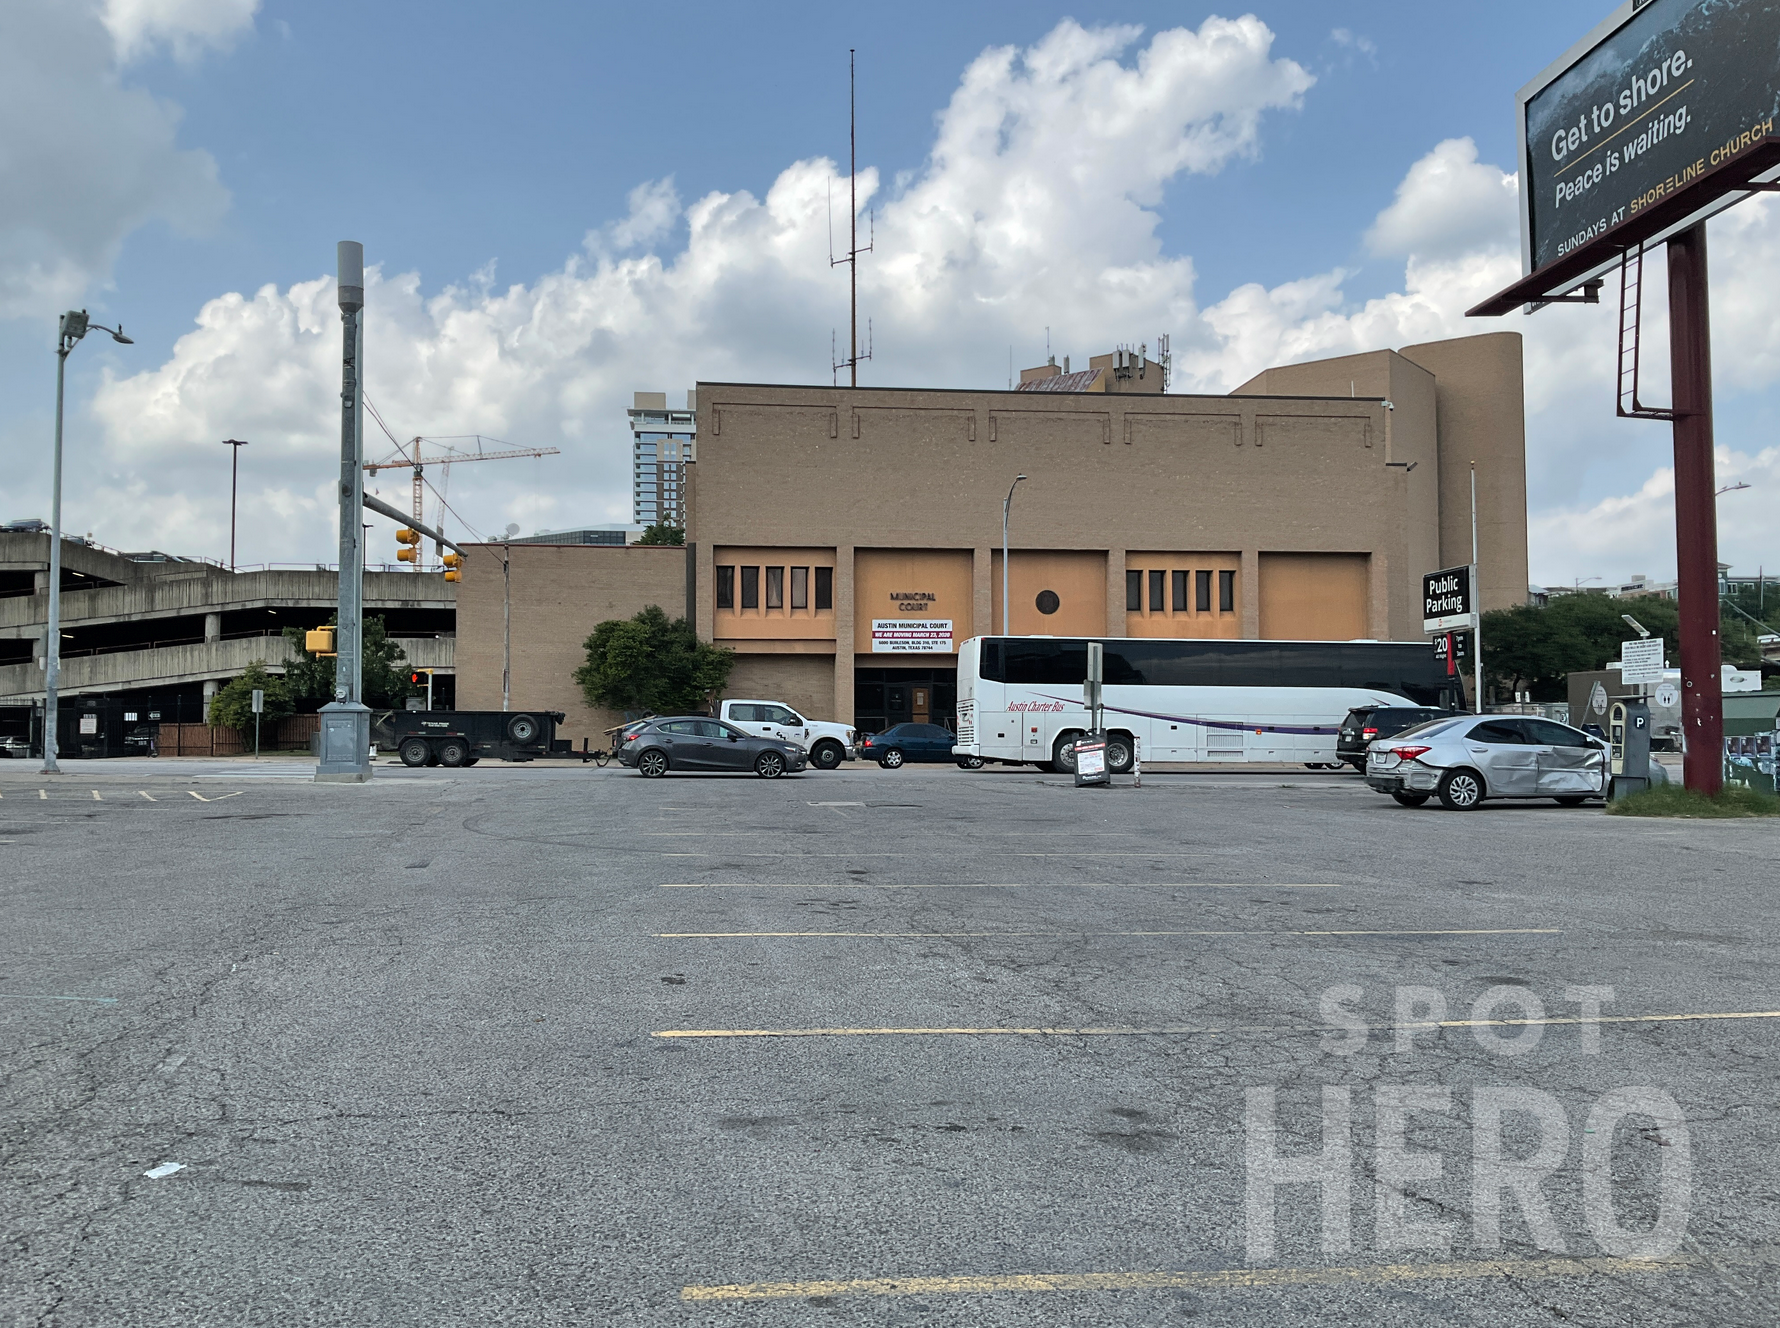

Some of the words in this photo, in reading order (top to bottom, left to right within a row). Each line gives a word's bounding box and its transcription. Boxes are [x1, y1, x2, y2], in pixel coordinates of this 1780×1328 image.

[1552, 116, 1588, 161] Get
[1592, 101, 1614, 133] to
[1619, 49, 1693, 116] shore.
[1555, 163, 1603, 208] Peace
[1606, 150, 1619, 176] is
[1623, 105, 1691, 164] waiting.
[1557, 218, 1607, 257] SUNDAYS
[1611, 206, 1626, 227] AT
[1710, 117, 1773, 166] CHURCH
[1429, 575, 1458, 595] Public
[890, 593, 936, 601] MUNICIPAL
[1426, 595, 1463, 614] Parking
[899, 603, 928, 611] COURT
[1434, 637, 1448, 653] $20
[1006, 701, 1028, 712] Austin
[1028, 701, 1052, 712] Charter
[1052, 701, 1066, 712] Bus
[1636, 717, 1644, 728] P
